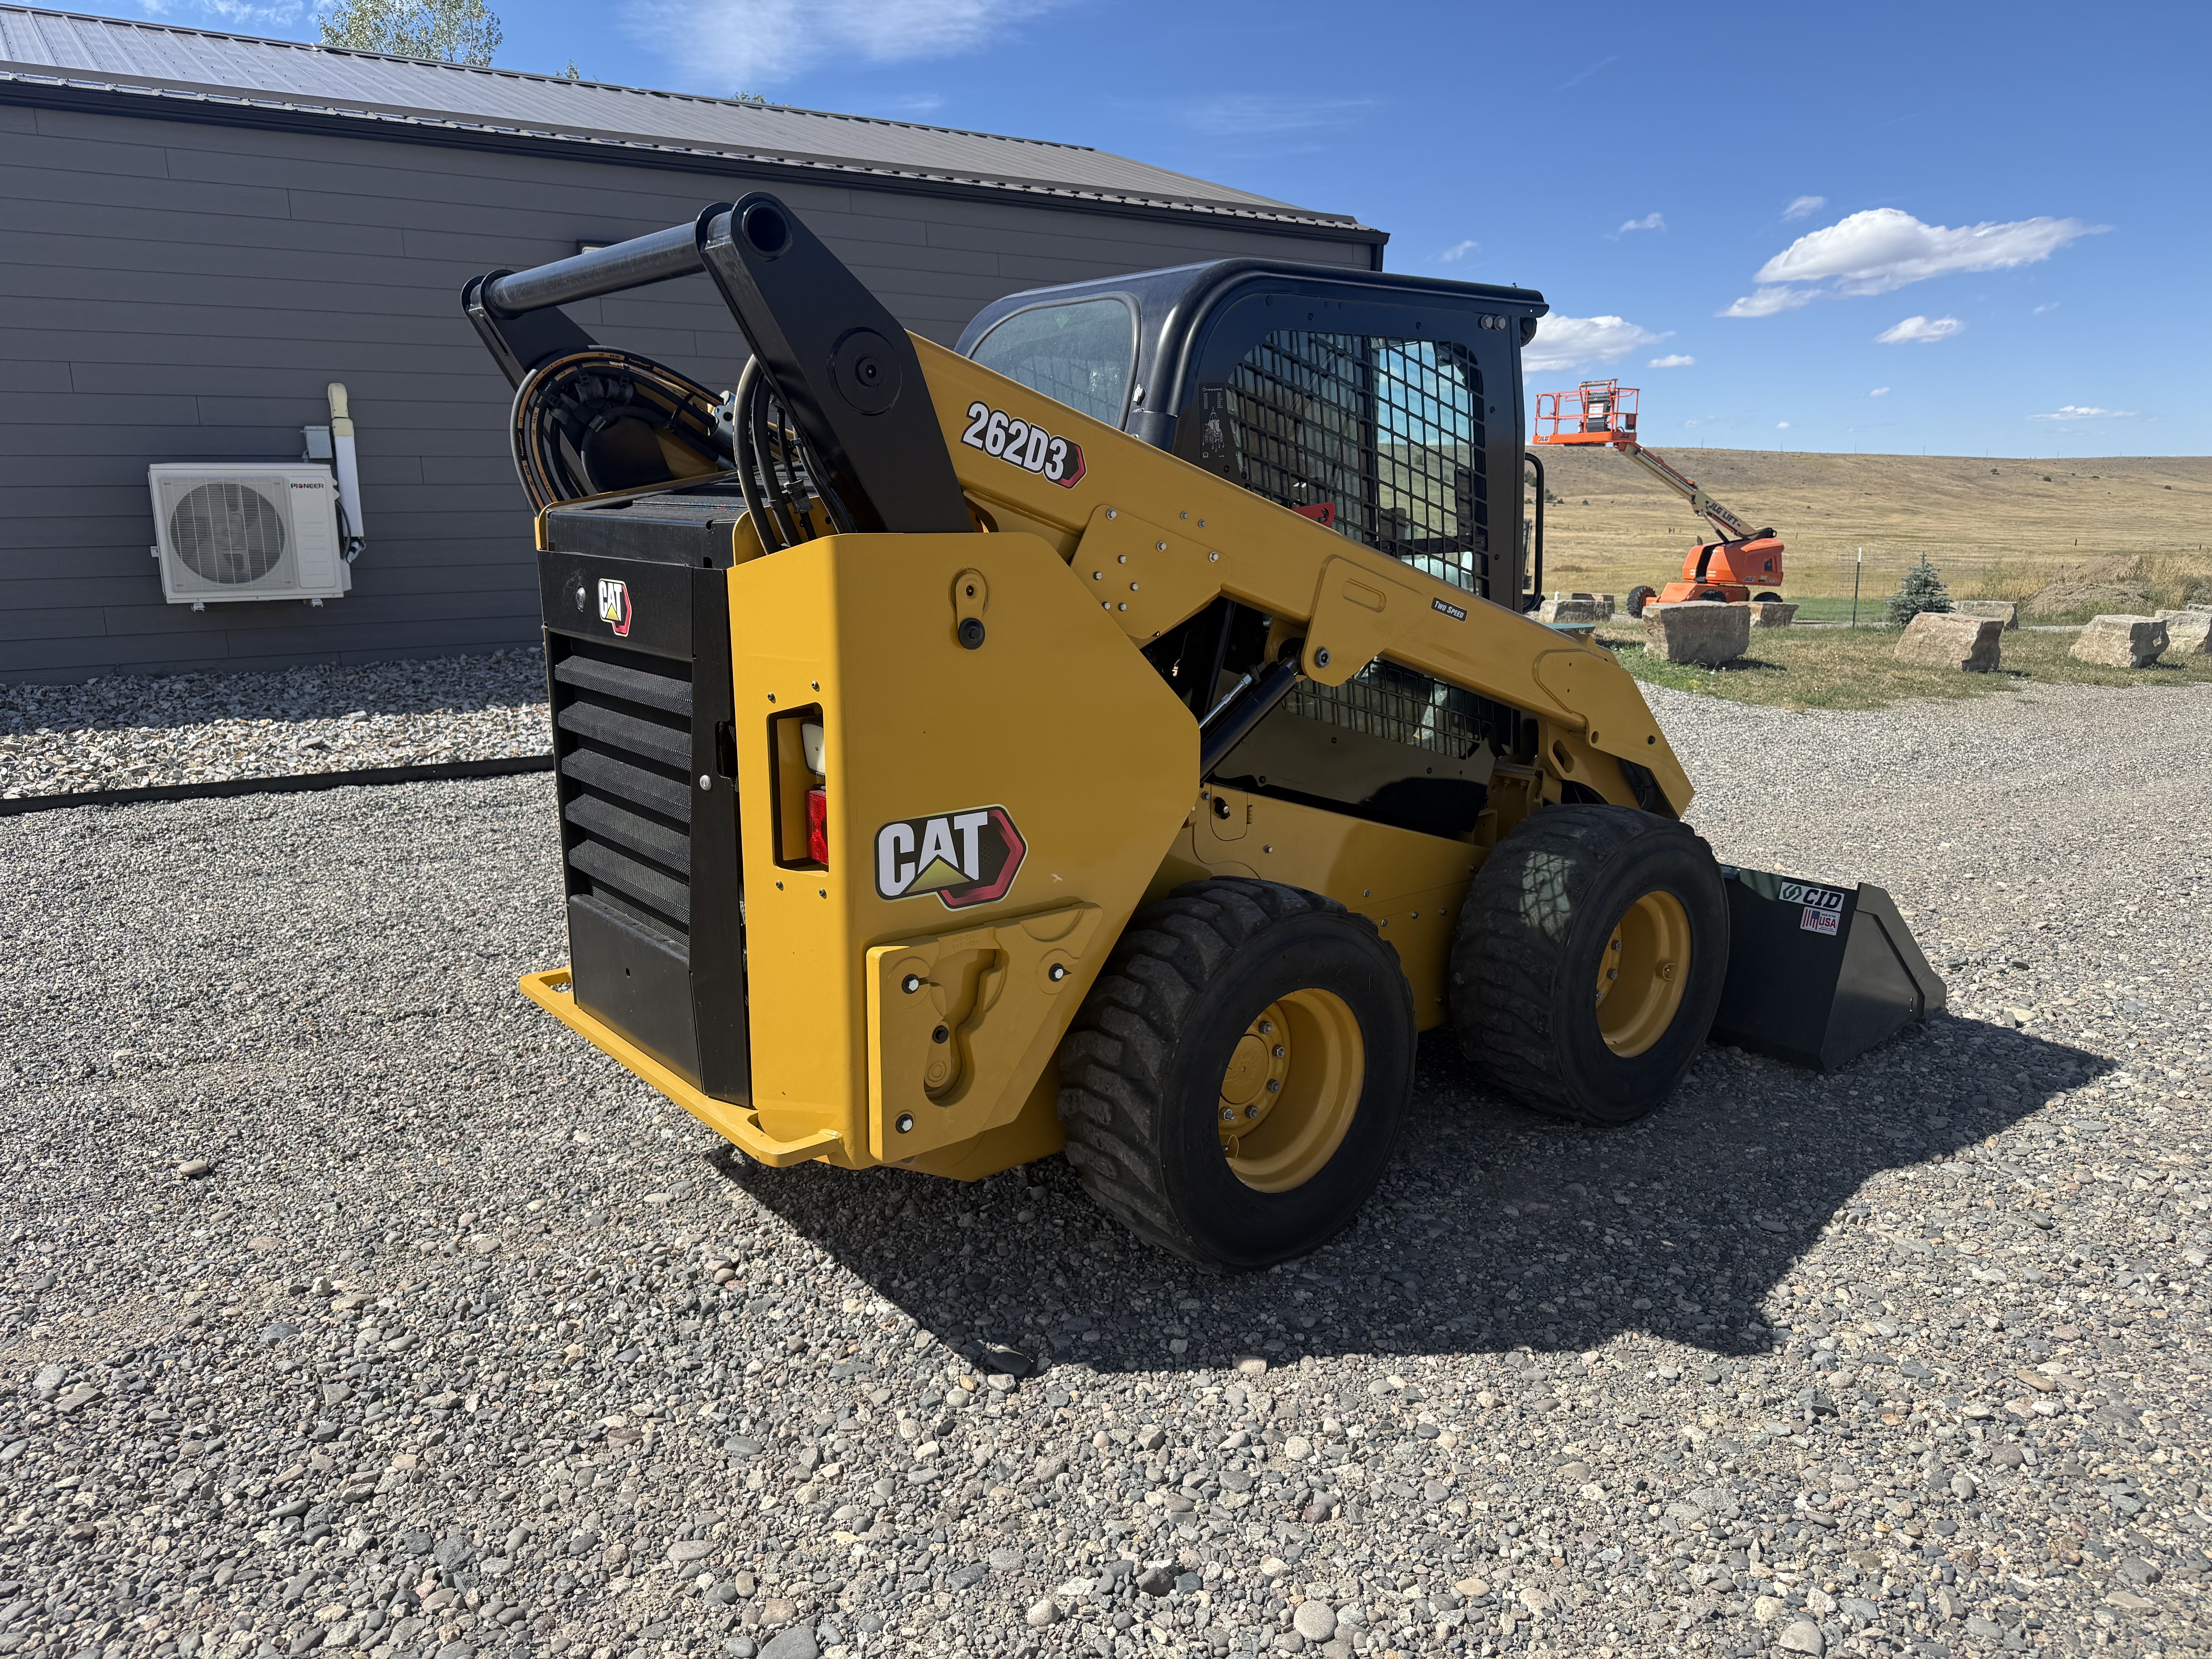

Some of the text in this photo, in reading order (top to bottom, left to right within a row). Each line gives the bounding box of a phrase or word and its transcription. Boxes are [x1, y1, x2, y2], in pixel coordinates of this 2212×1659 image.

[962, 403, 1068, 481] 262D3
[1708, 503, 1738, 525] JLG LIFT
[599, 580, 622, 621] CAT
[878, 811, 988, 896] CAT
[1803, 889, 1842, 908] CID
[1819, 916, 1836, 928] USA
